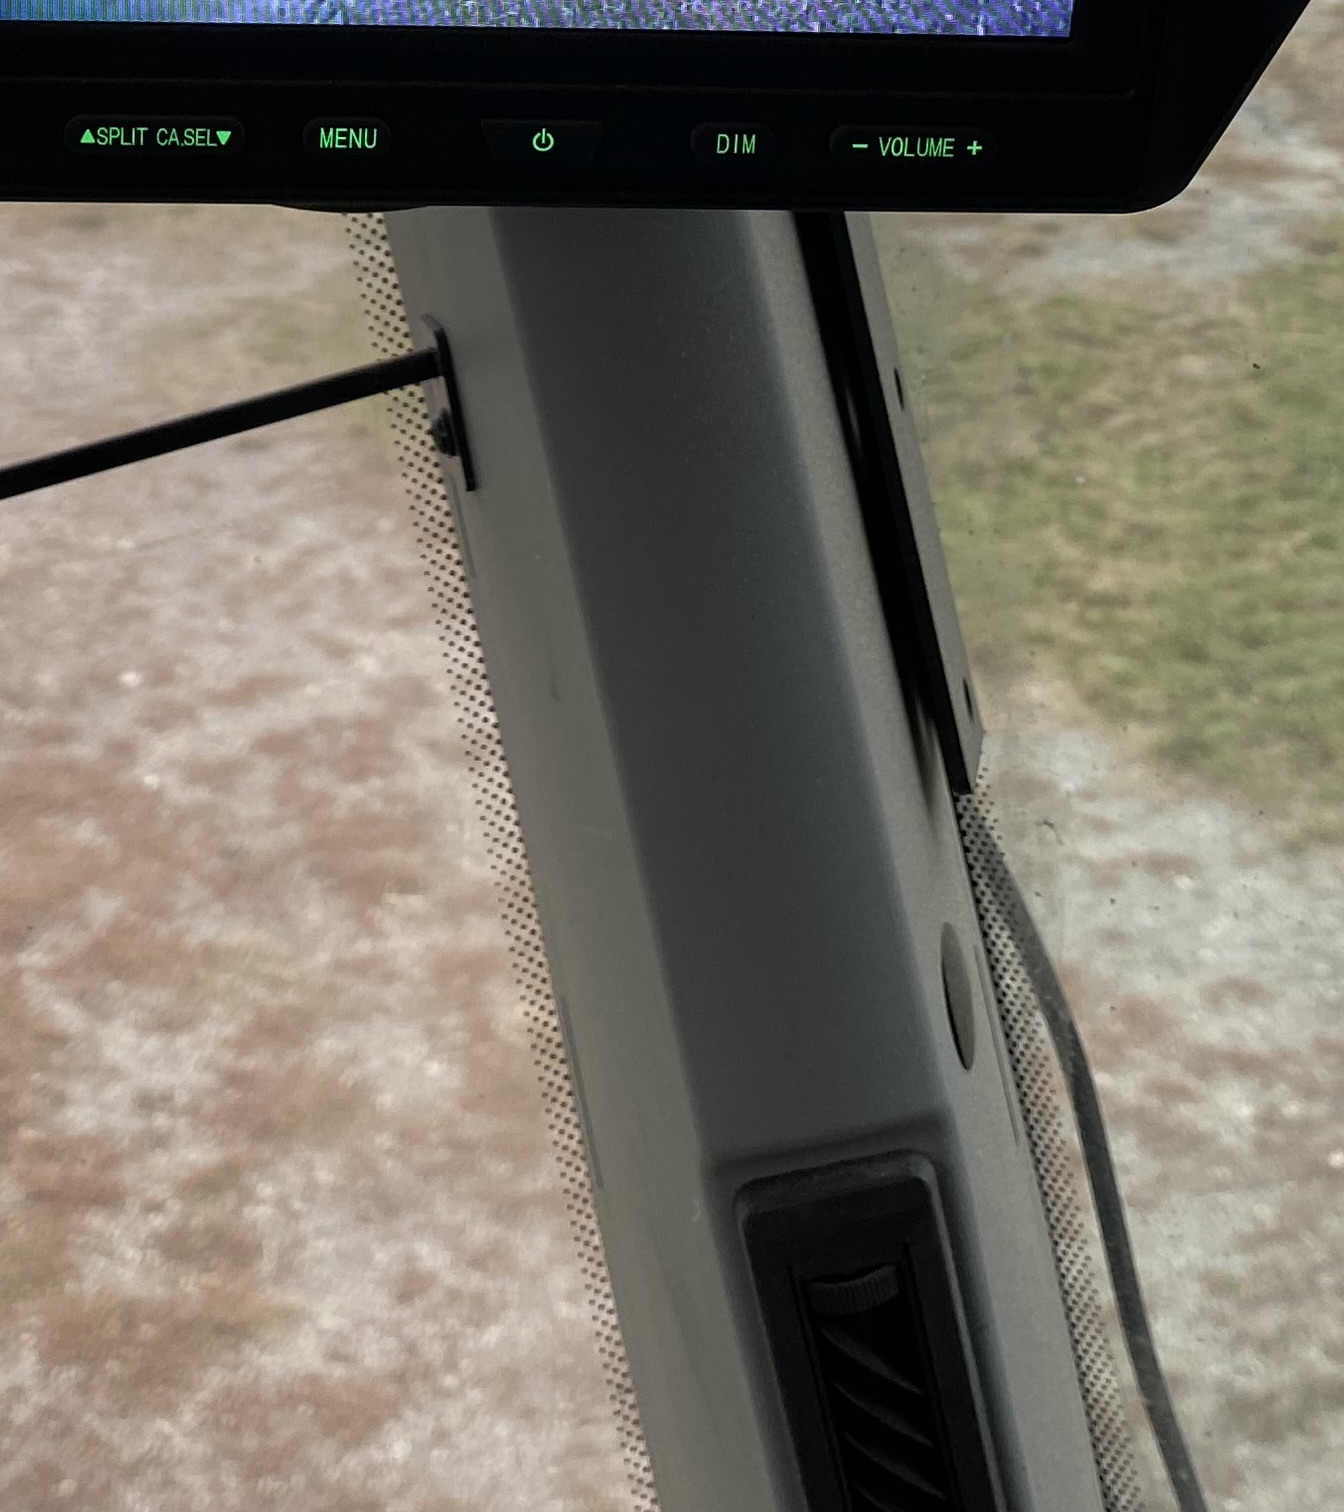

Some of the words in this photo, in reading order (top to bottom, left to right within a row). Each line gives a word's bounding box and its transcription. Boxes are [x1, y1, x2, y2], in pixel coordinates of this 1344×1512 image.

[96, 126, 149, 146] SPLIT
[319, 127, 378, 149] MENU
[716, 133, 756, 154] DIM
[878, 136, 956, 158] VOLUME
